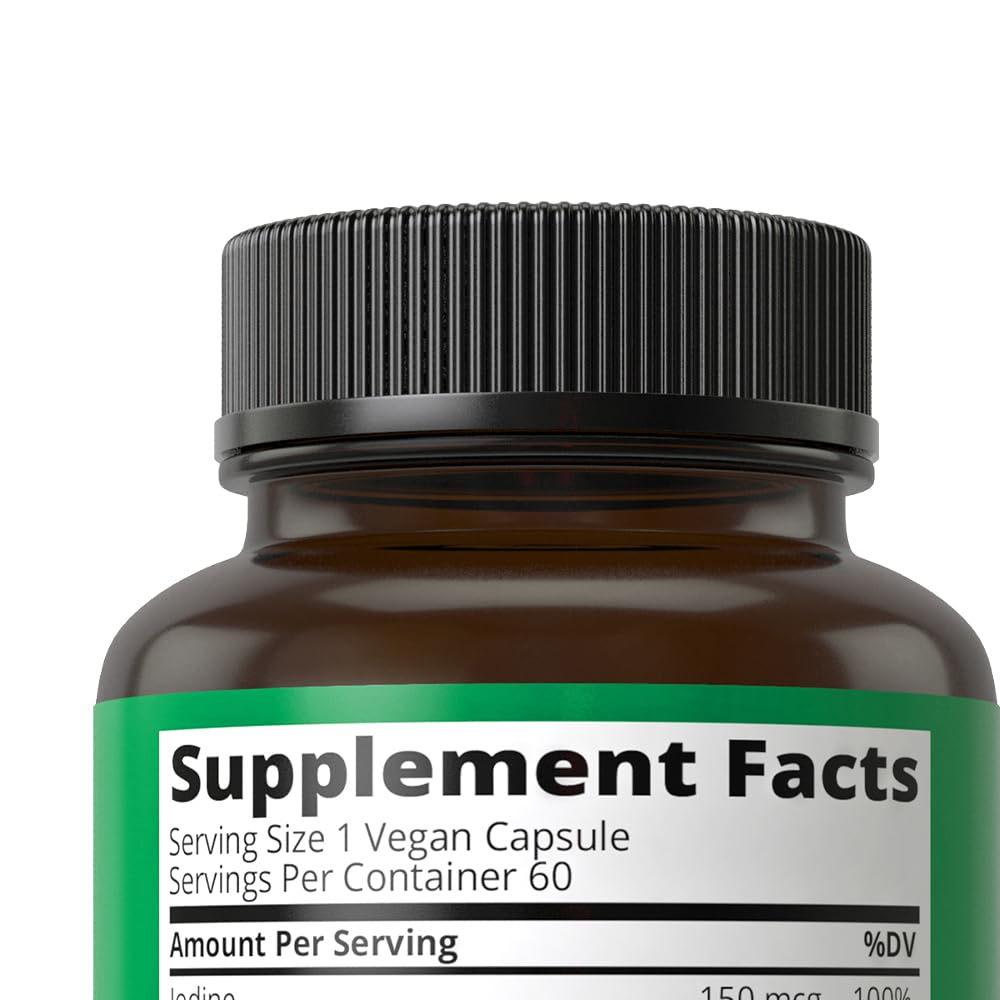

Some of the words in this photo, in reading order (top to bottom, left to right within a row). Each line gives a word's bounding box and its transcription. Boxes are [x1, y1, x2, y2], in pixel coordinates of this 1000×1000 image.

[171, 735, 697, 819] Supplement
[728, 738, 919, 804] Facts
[169, 825, 258, 864] Serving
[266, 823, 325, 854] Size
[338, 822, 348, 853] 1
[364, 822, 471, 861] Vegan
[486, 819, 630, 861] Capsule
[169, 864, 272, 903] Servings
[283, 863, 334, 893] Per
[343, 860, 518, 893] Container
[529, 860, 572, 892] 60
[169, 931, 267, 958] Amount
[276, 930, 325, 957] Per
[333, 927, 459, 965] Serving
[863, 930, 917, 958] %DV
